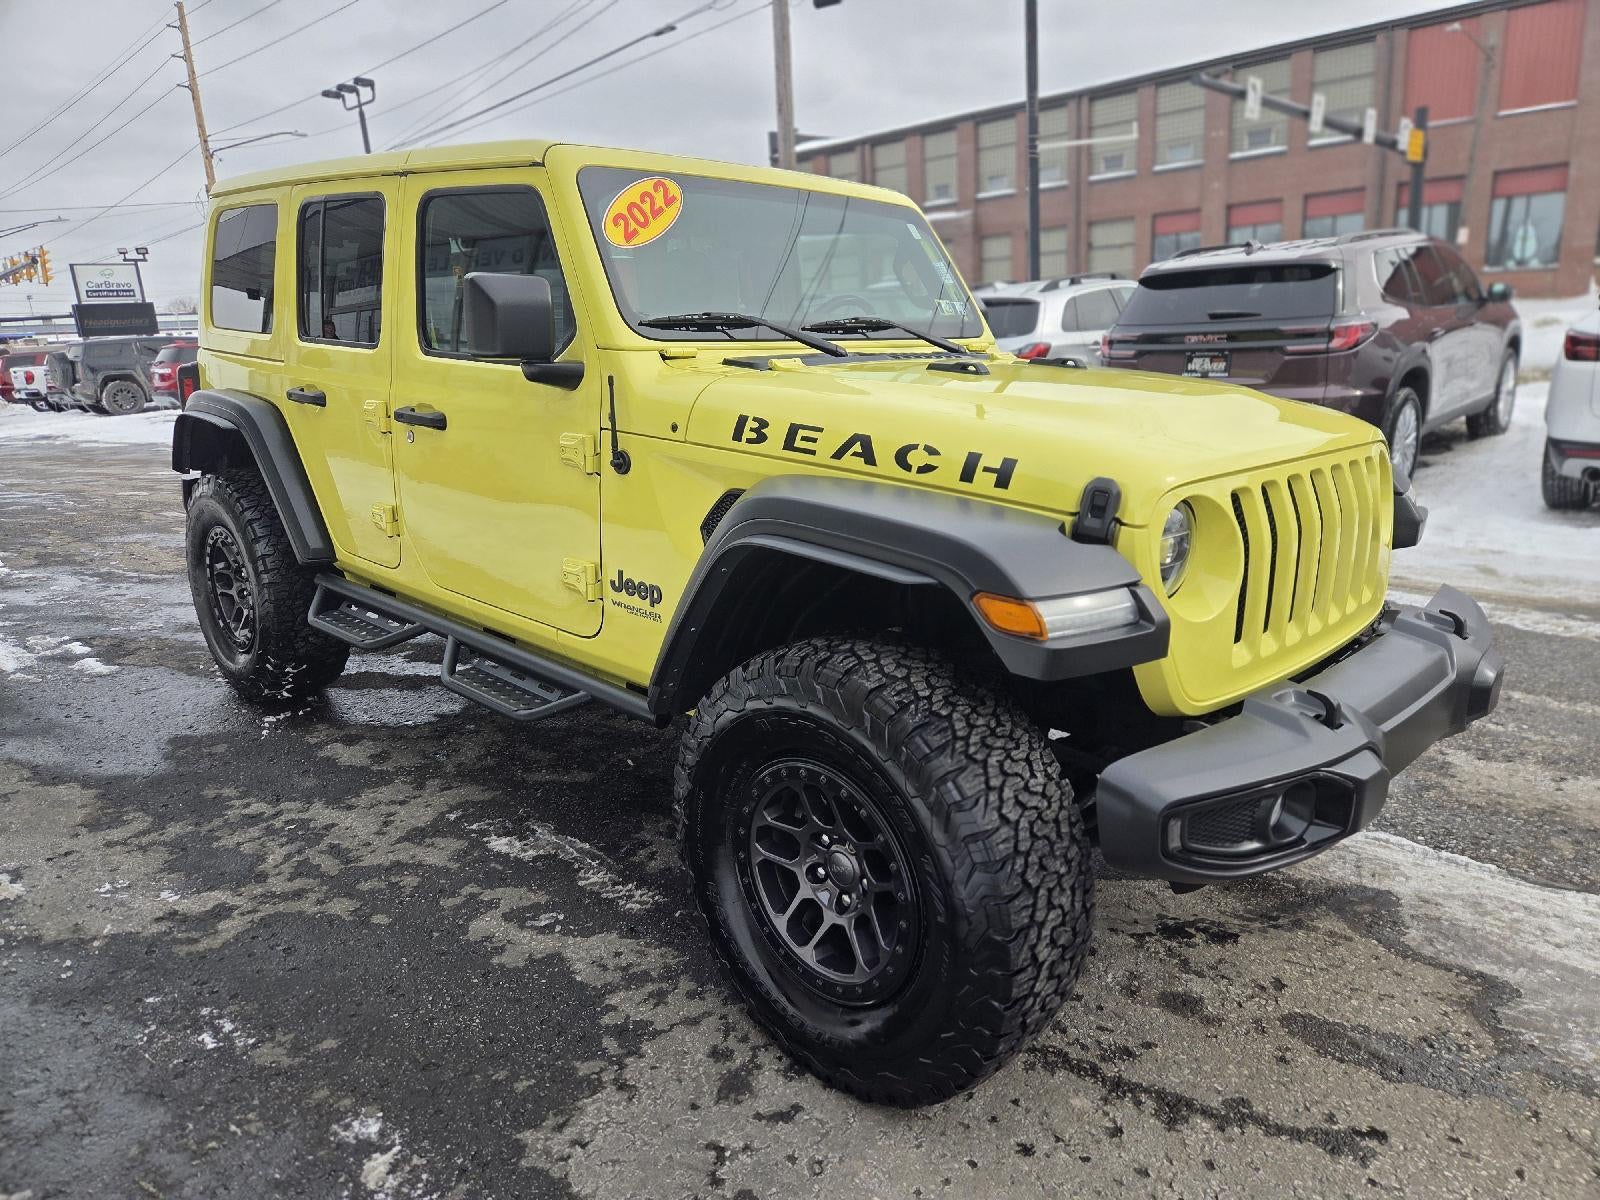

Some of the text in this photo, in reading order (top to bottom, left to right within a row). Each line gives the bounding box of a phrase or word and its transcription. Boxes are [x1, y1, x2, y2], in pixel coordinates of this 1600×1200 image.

[612, 178, 678, 244] 2022
[86, 280, 132, 289] CarBravo
[1184, 334, 1227, 344] GMC
[731, 413, 1019, 490] BEACH
[609, 568, 663, 608] Jeep
[610, 598, 662, 620] WRANGLER
